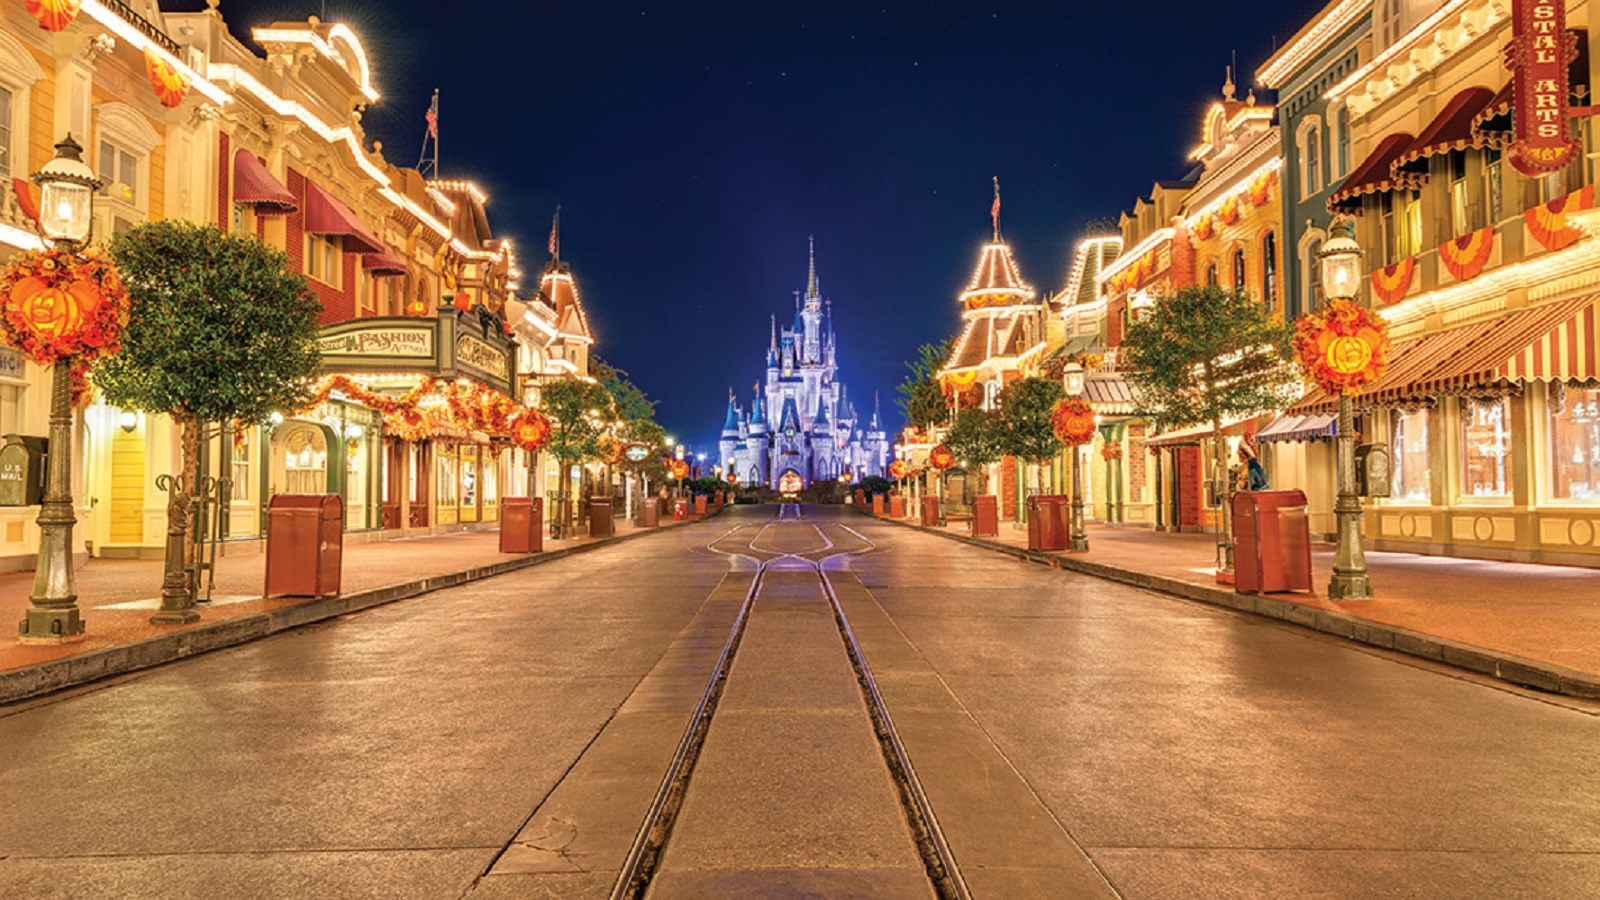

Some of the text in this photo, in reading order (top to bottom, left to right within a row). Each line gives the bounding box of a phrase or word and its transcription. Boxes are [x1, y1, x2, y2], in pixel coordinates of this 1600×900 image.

[1533, 0, 1559, 137] STAL ARTS
[358, 332, 427, 353] FASHION
[0, 473, 23, 481] MAIL
